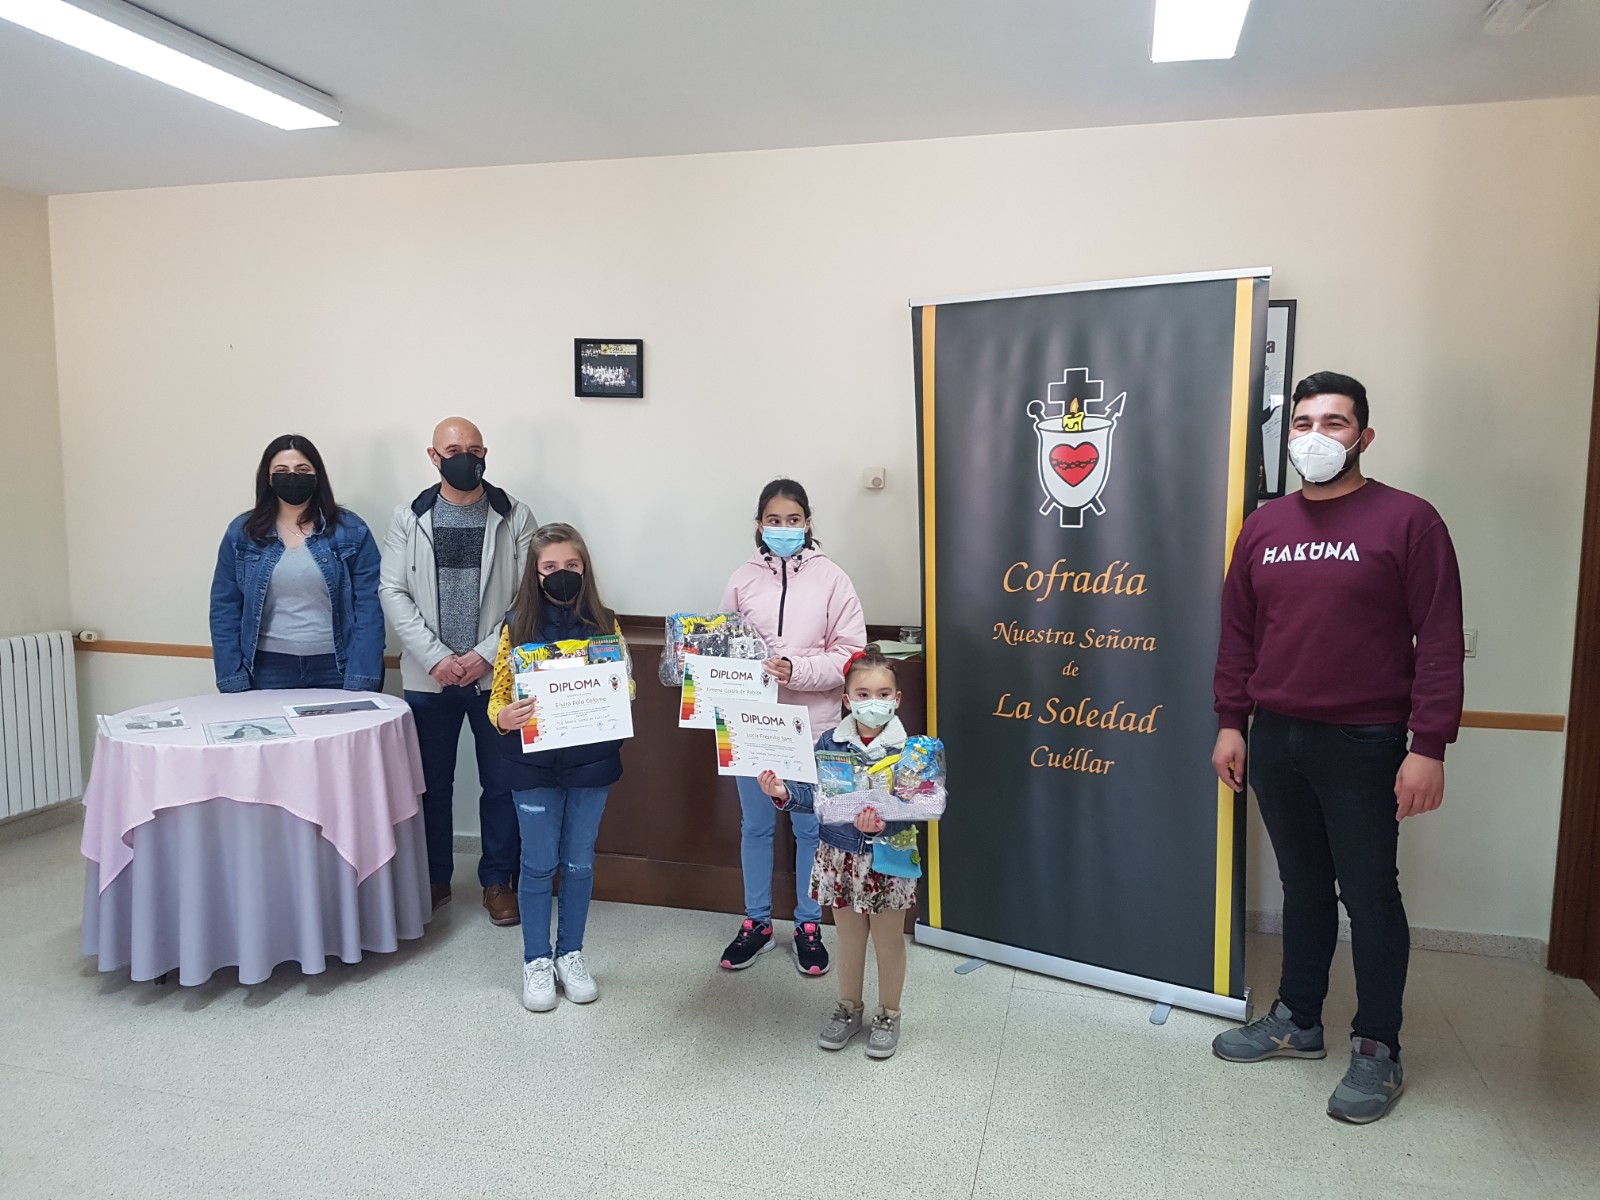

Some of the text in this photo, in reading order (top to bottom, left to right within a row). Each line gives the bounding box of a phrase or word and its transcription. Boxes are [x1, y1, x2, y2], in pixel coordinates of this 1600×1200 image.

[1262, 541, 1360, 565] HAKUNA
[1003, 558, 1147, 602] Cofradía
[992, 620, 1157, 651] Nuestra Señora
[710, 668, 754, 681] DIPLOMA
[1062, 660, 1079, 677] de
[549, 678, 601, 694] DIPLOMA
[741, 713, 786, 727] DIPLOMA
[992, 693, 1163, 734] La Soledad
[1030, 745, 1115, 775] Cuéllar
